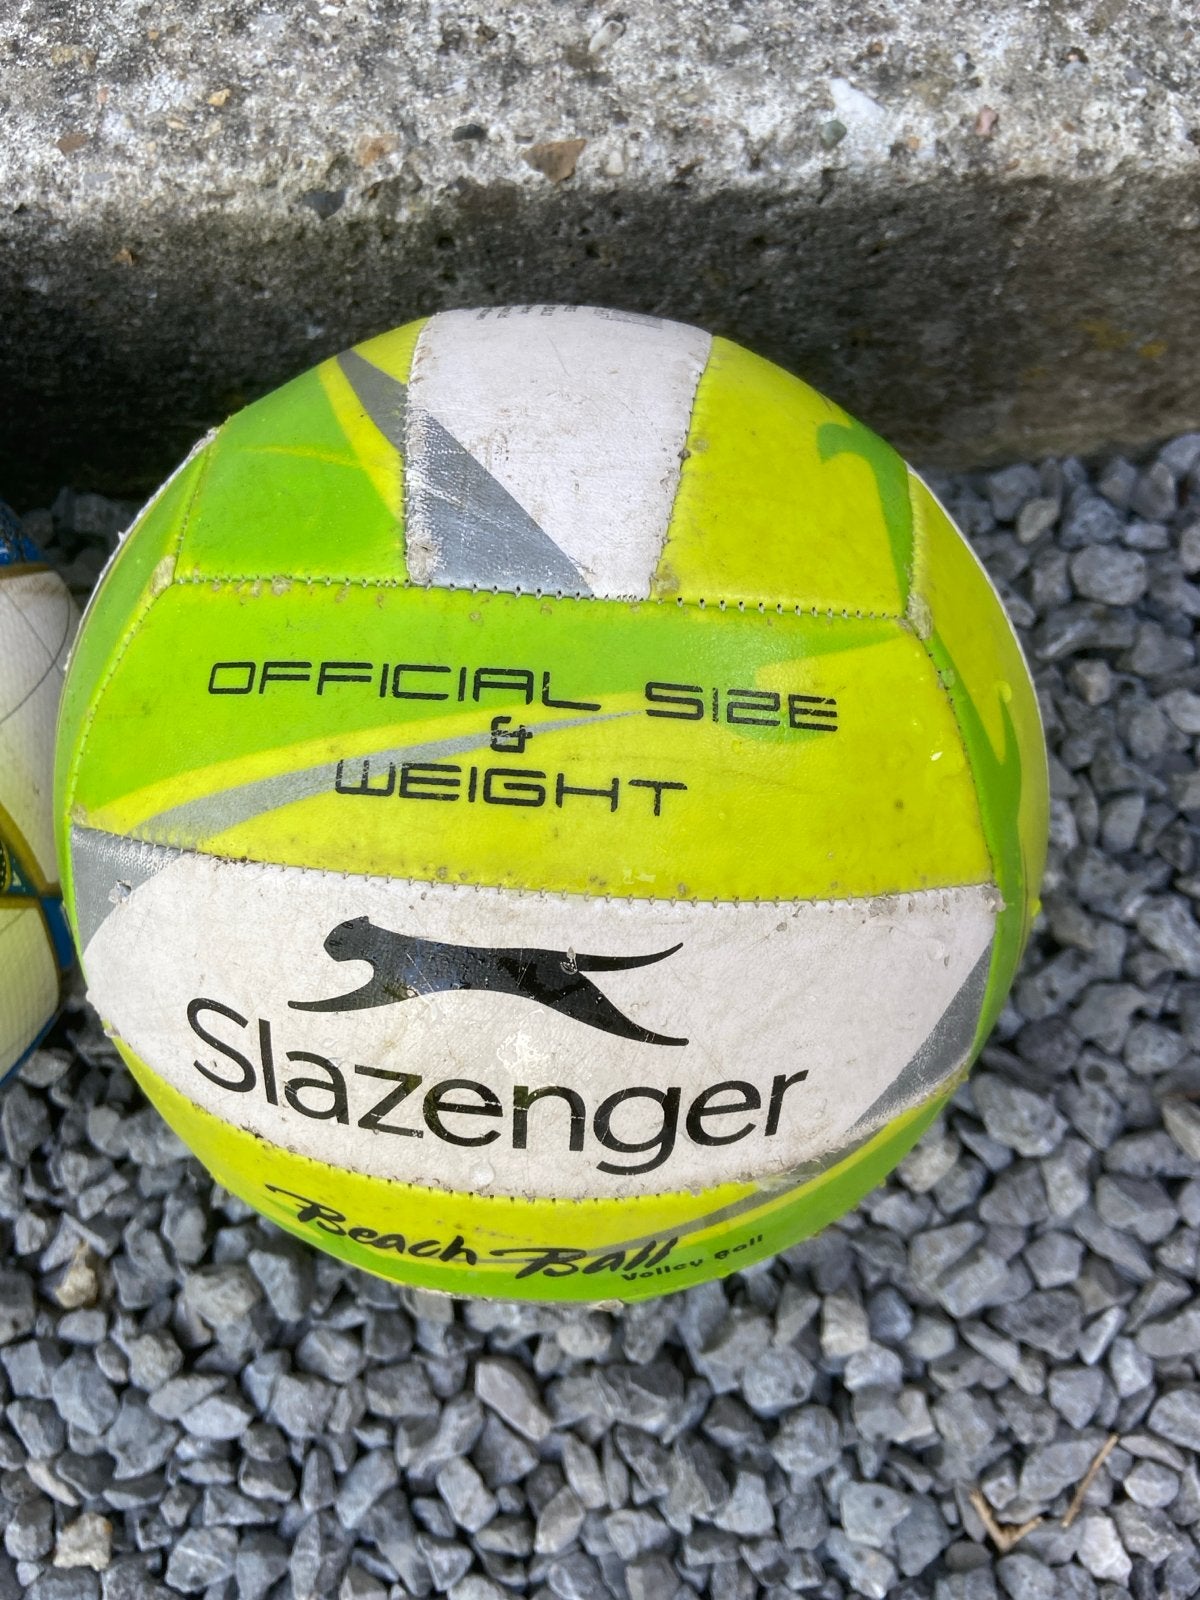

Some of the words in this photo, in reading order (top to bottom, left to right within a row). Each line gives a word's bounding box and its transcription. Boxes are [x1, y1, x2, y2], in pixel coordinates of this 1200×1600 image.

[208, 661, 602, 712] OFFICIAL
[644, 681, 838, 732] SIZE
[489, 715, 534, 754] &
[335, 759, 688, 817] WEIGHT
[186, 997, 809, 1176] Slazenger
[264, 1183, 479, 1266] Beach
[489, 1236, 679, 1280] Ball
[620, 1258, 704, 1282] Volley
[713, 1233, 764, 1260] Ball
